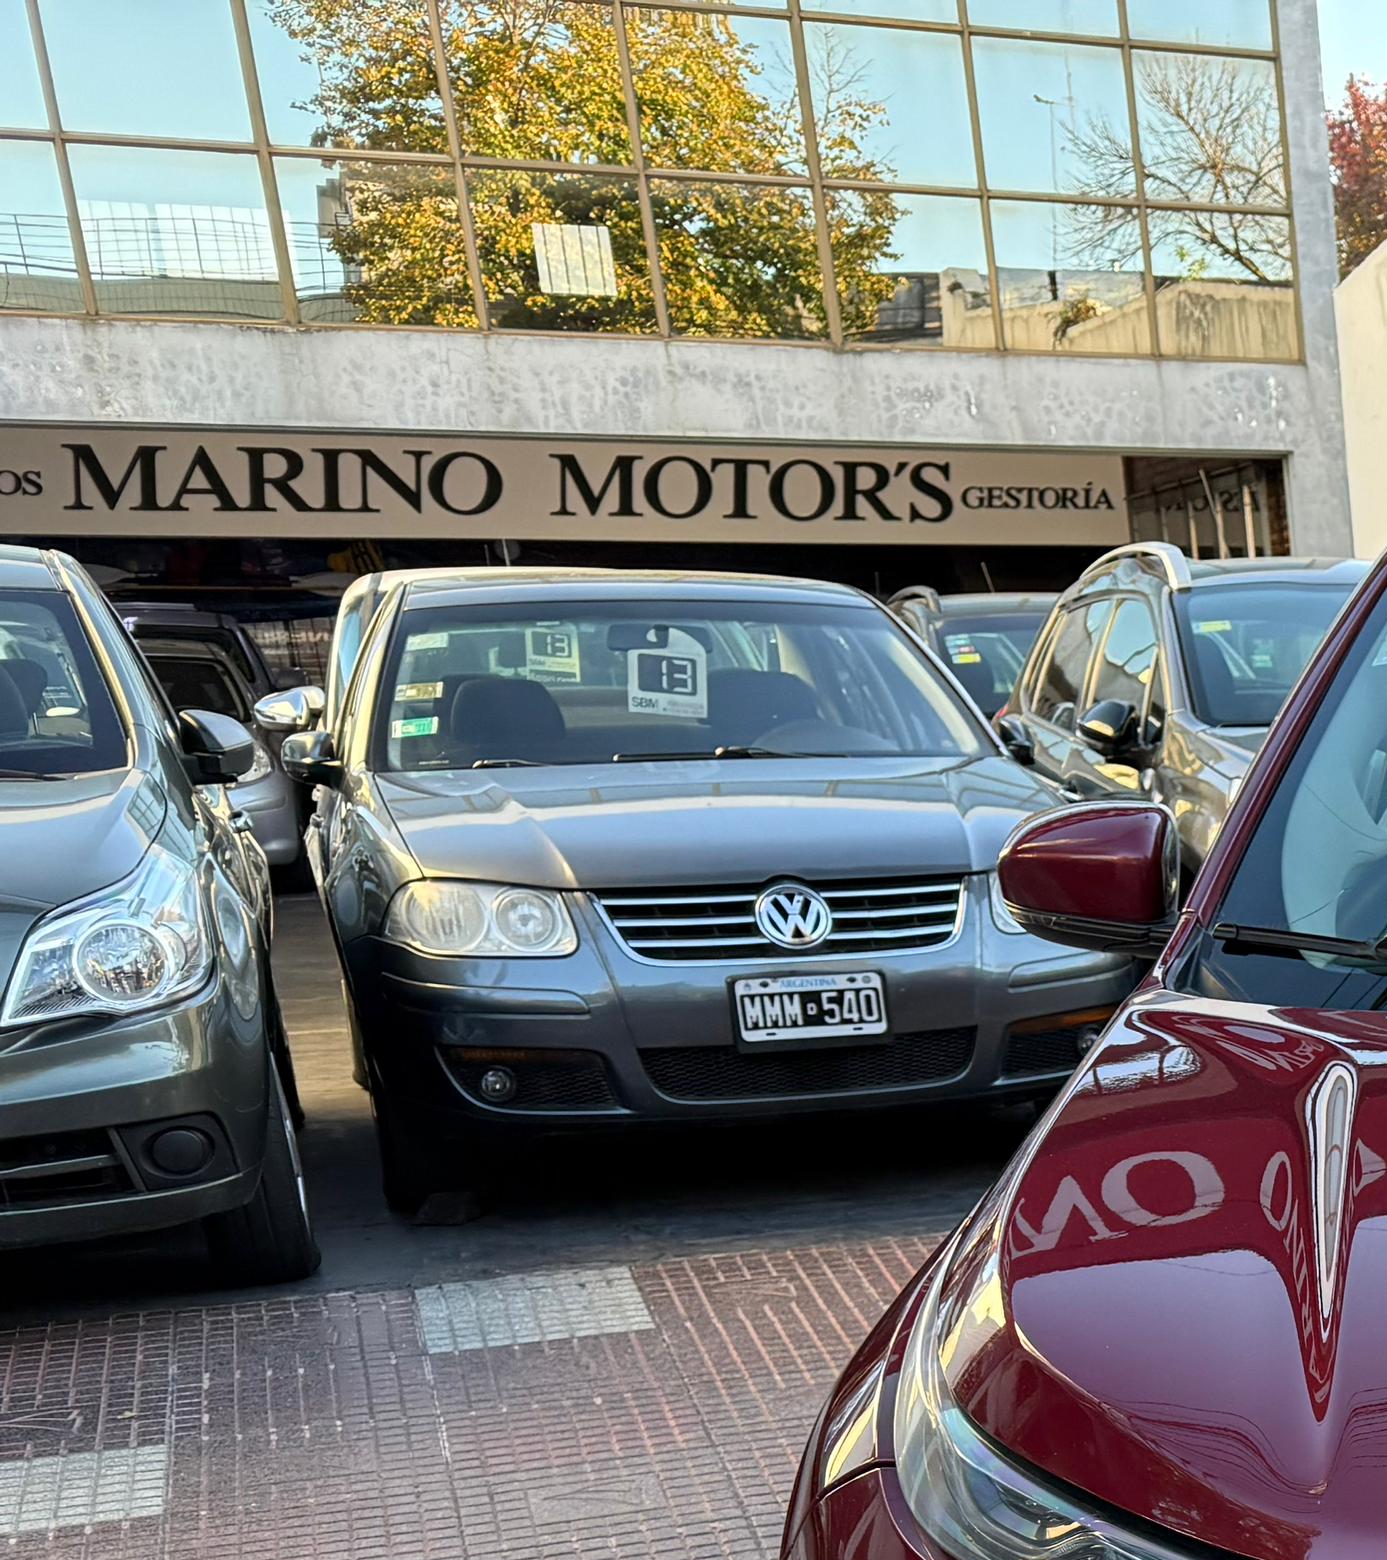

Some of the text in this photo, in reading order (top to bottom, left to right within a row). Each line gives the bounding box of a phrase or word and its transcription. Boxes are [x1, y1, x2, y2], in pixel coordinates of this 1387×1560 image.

[60, 442, 503, 516] MARINO
[960, 481, 1115, 511] GESTORÍA
[661, 659, 693, 693] 13
[779, 978, 838, 989] ARGENTINA
[742, 993, 805, 1029] MMM
[820, 988, 881, 1024] 540
